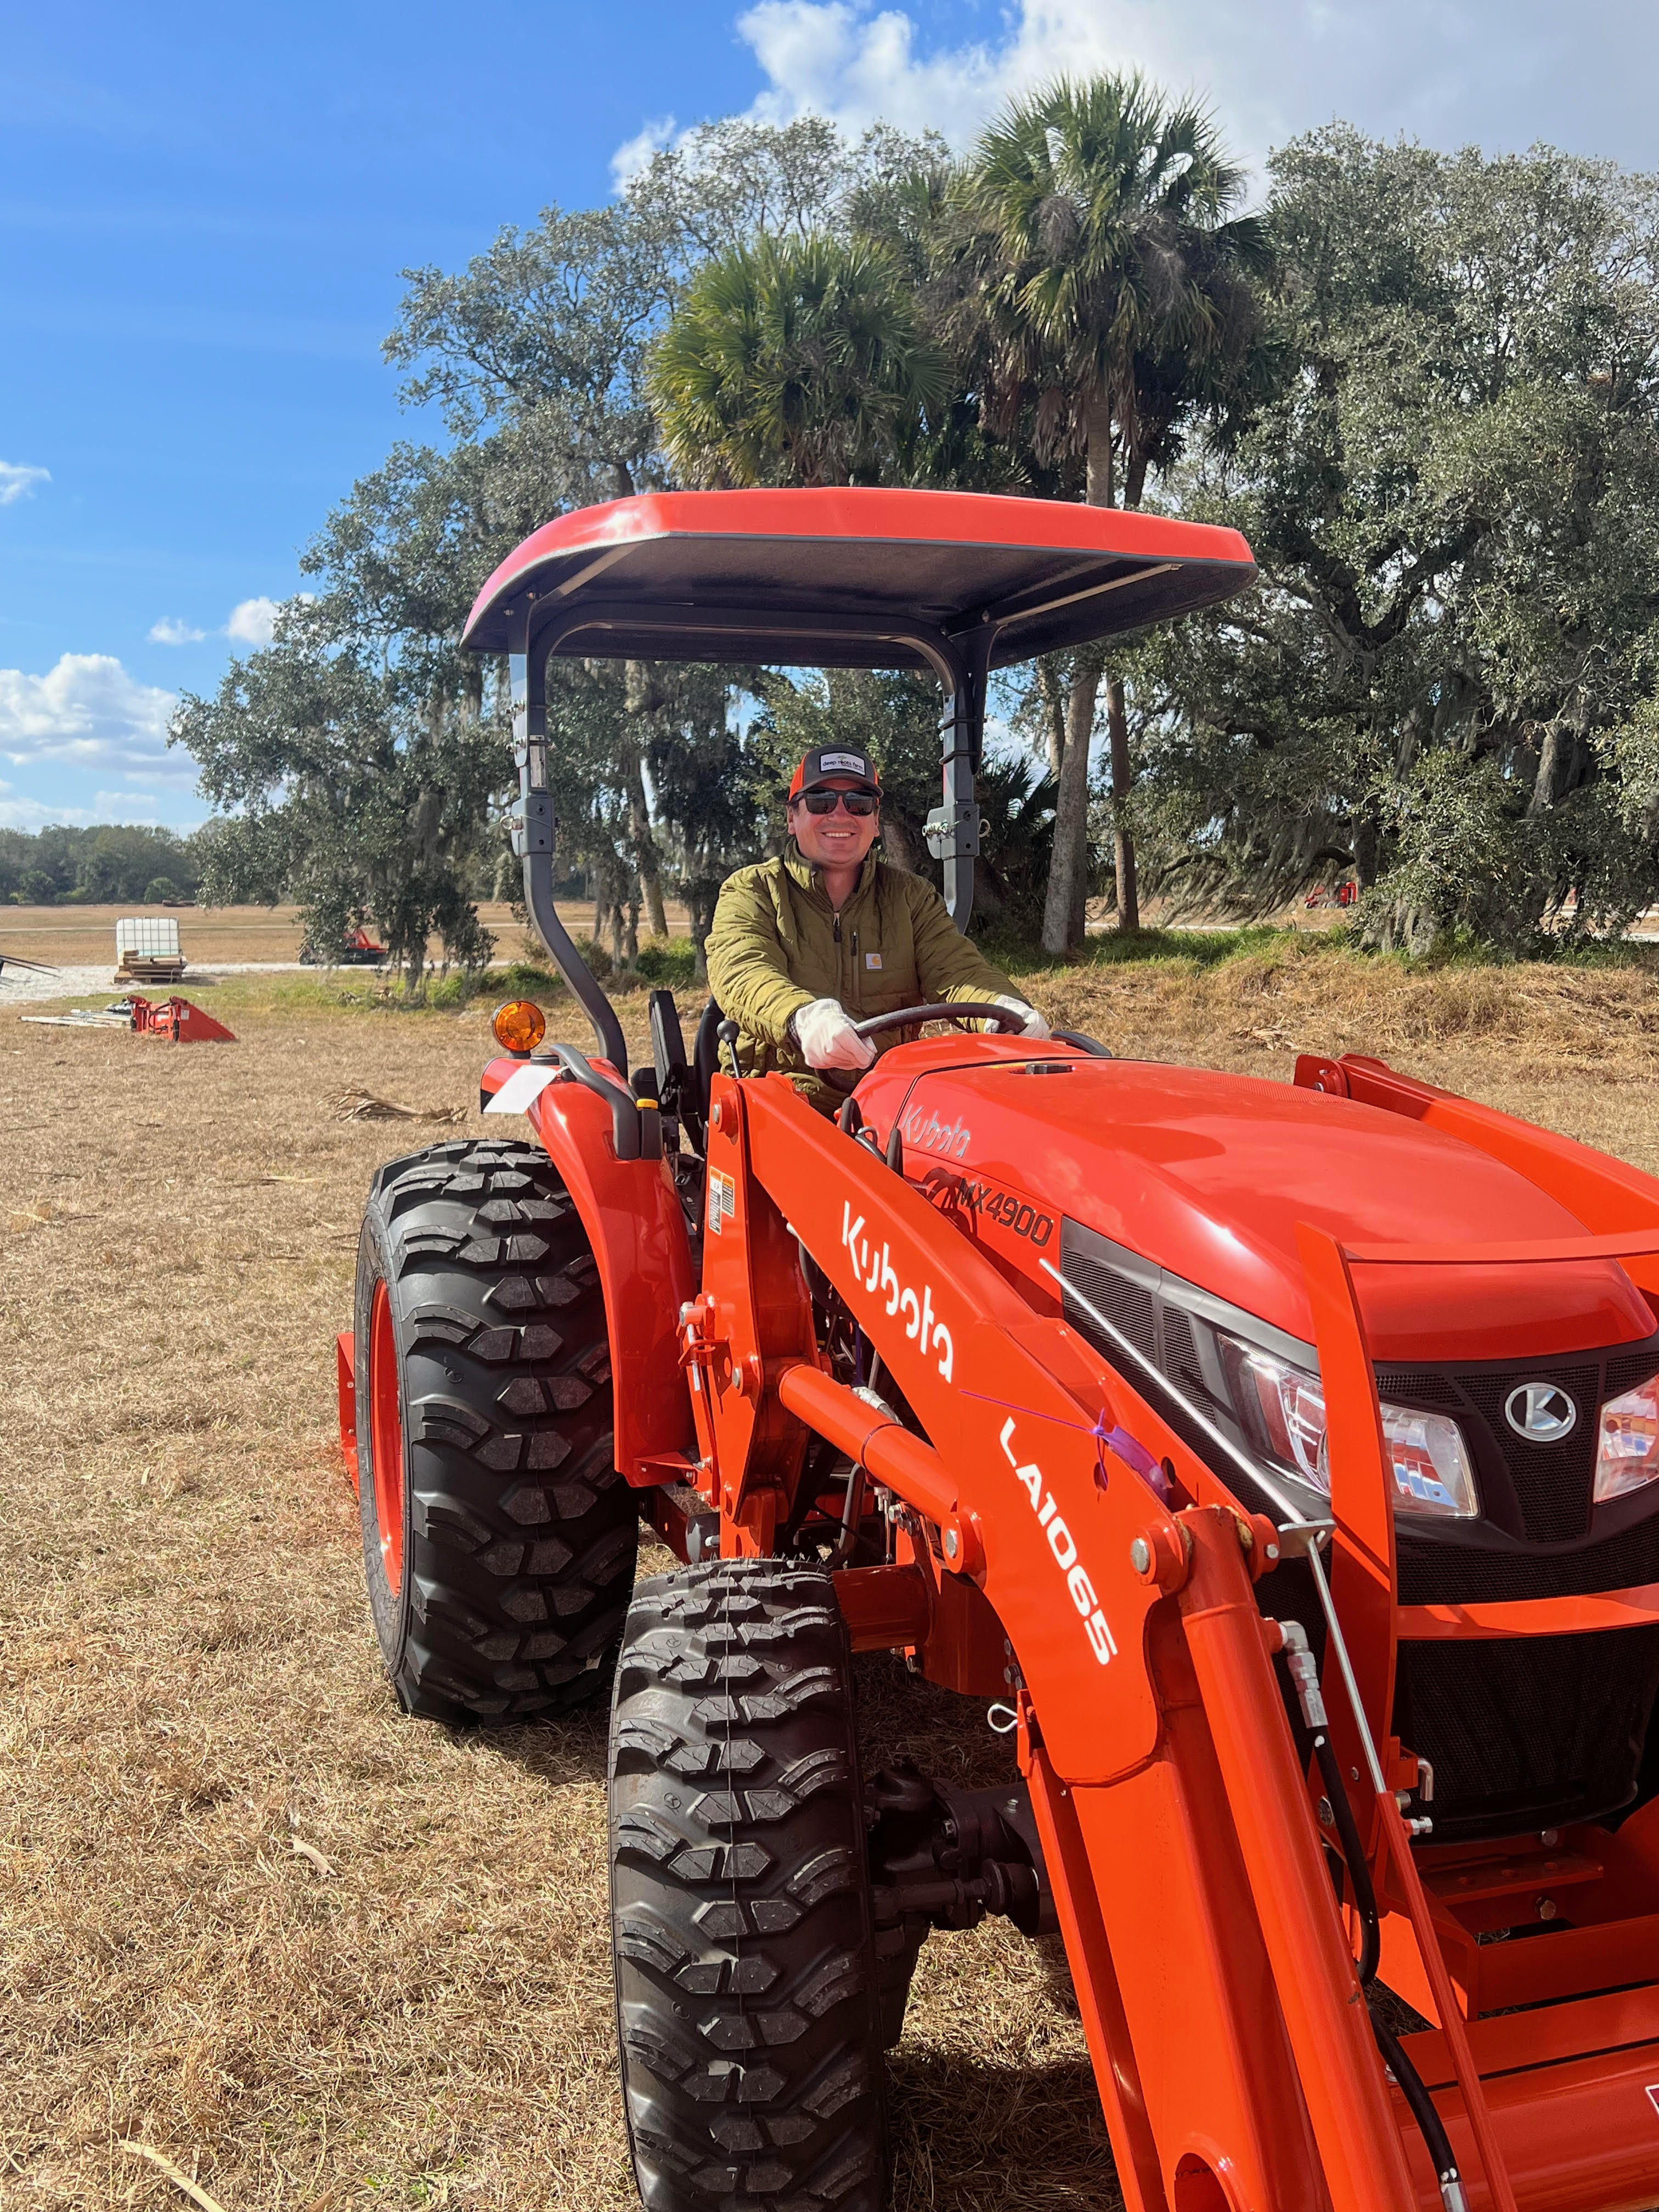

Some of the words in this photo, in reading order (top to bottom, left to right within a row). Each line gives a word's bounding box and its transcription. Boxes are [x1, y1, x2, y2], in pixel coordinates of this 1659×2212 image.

[901, 1104, 970, 1159] Kubota
[955, 1177, 1053, 1247] MX4900
[842, 1200, 953, 1384] Kubota
[1000, 1415, 1118, 1666] LA1065
